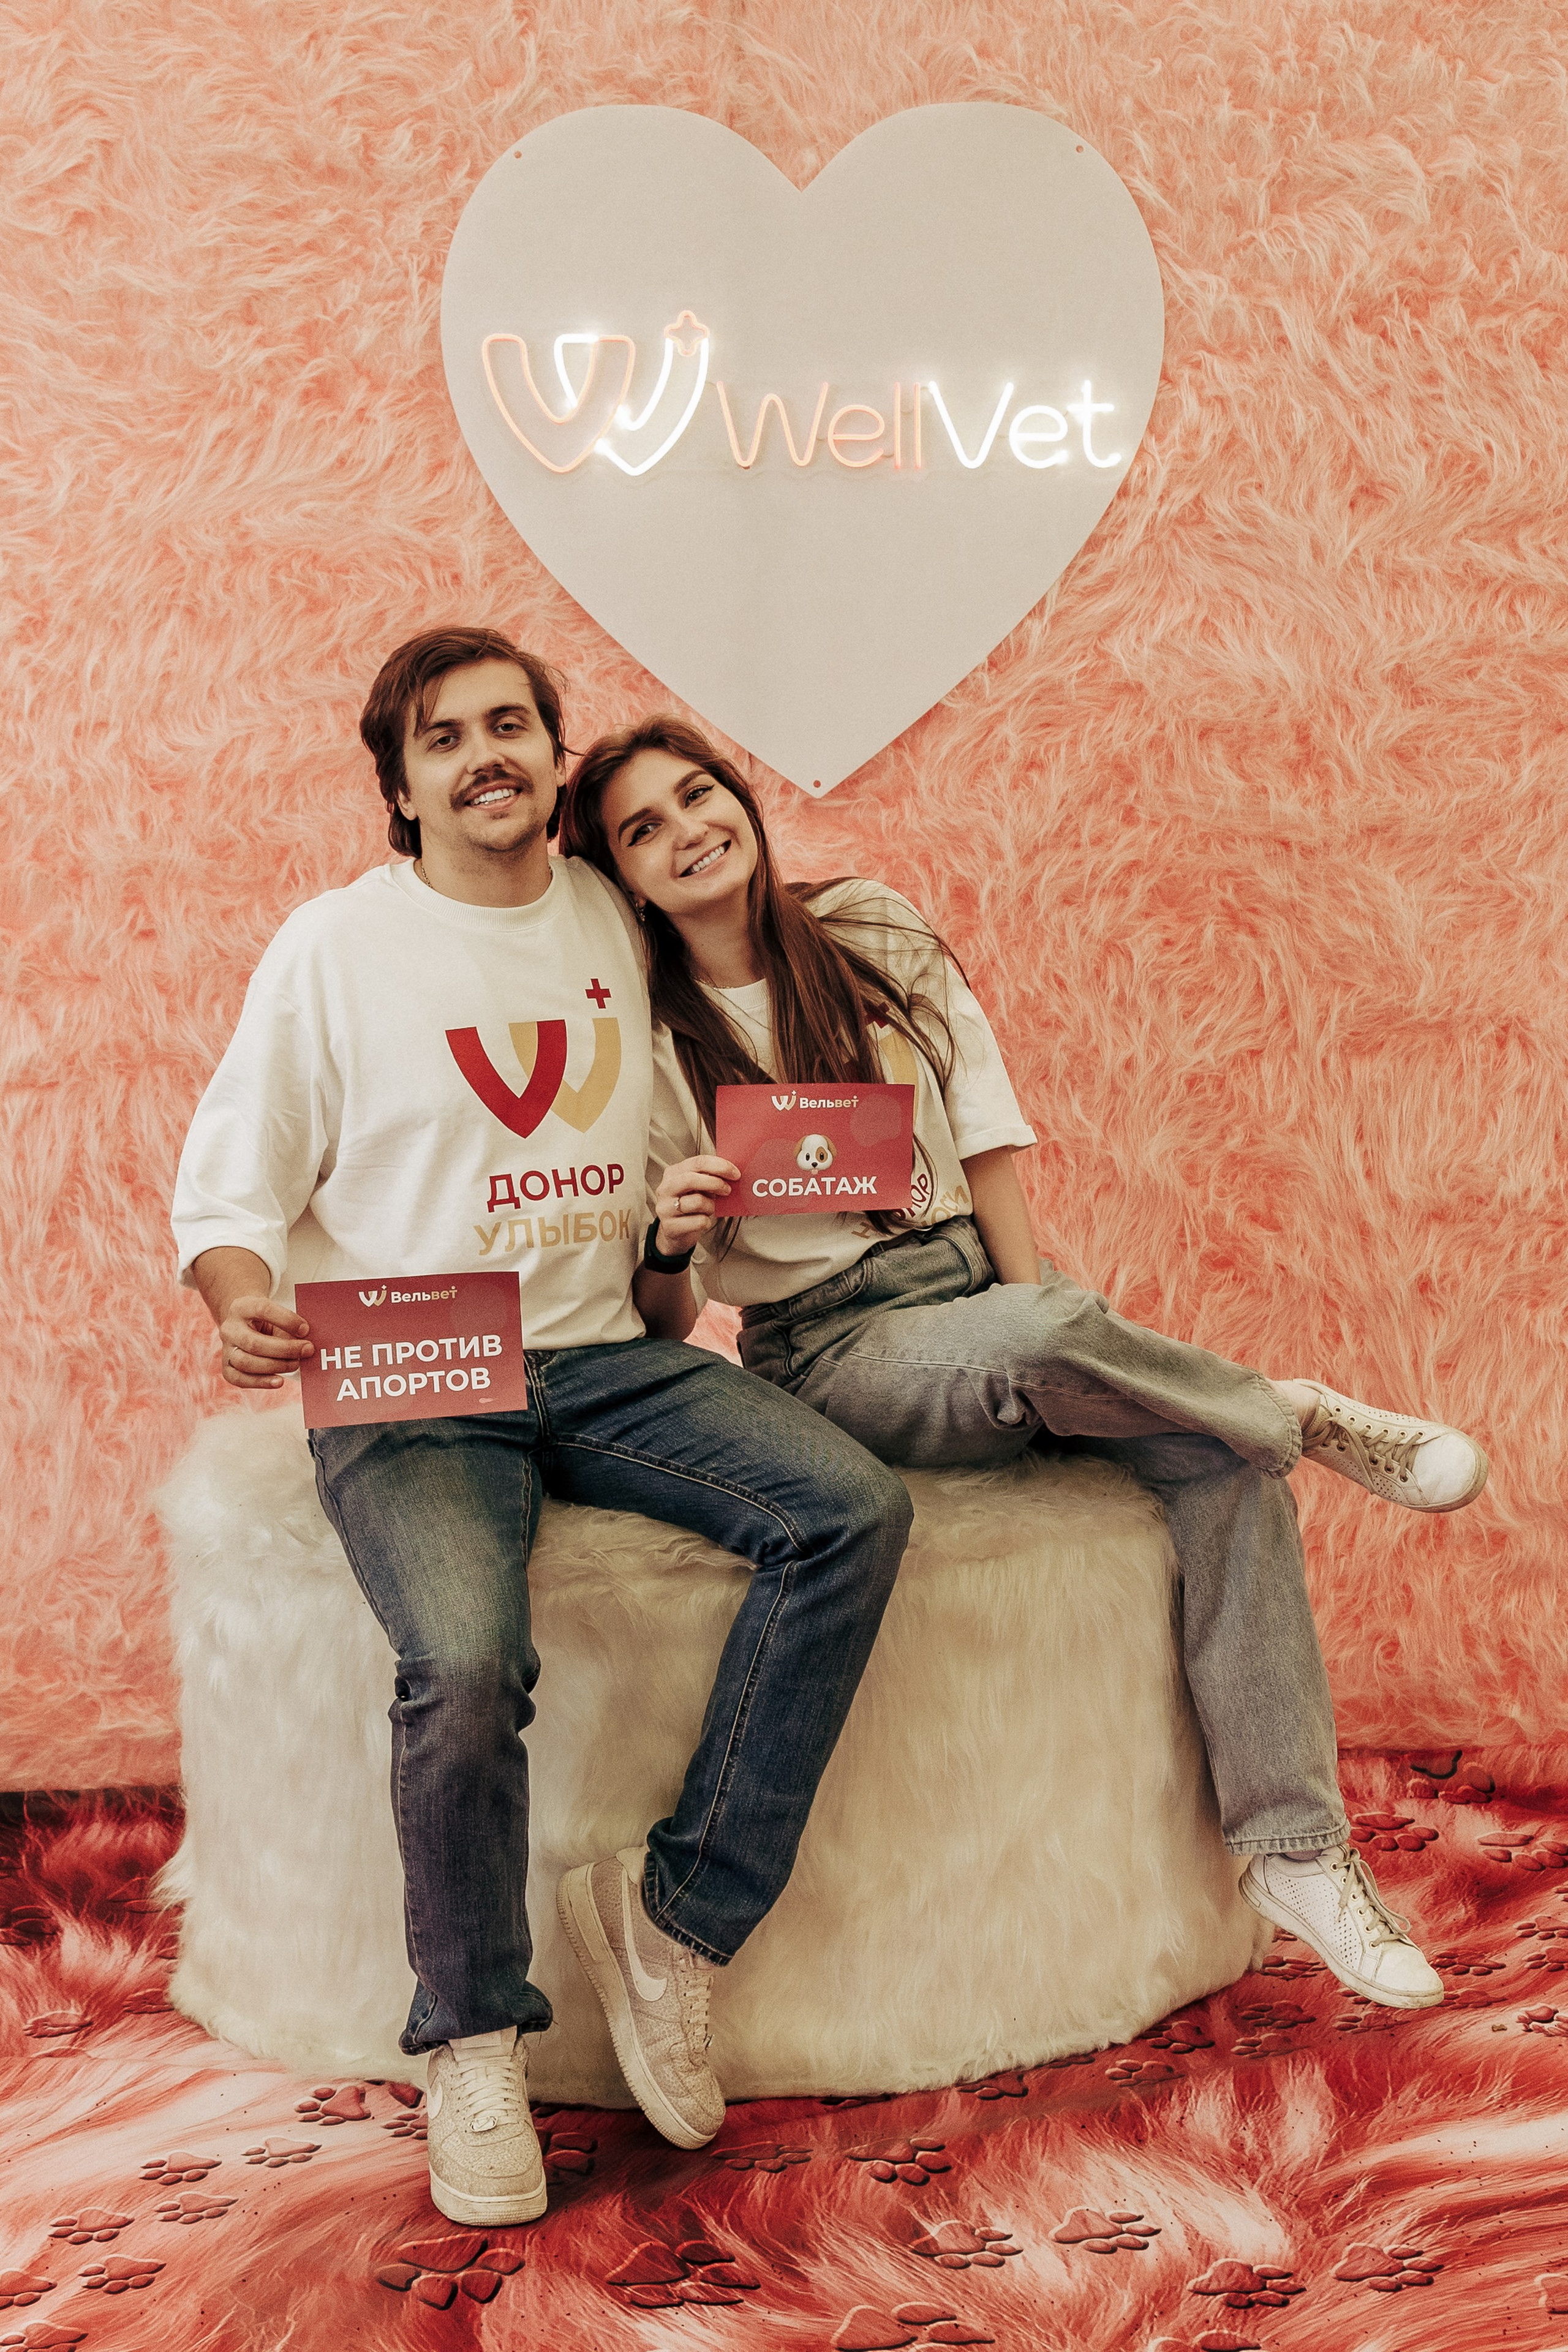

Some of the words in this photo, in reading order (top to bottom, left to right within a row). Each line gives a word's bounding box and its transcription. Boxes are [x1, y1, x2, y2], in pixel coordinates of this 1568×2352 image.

[716, 379, 1121, 470] WellVet
[799, 1096, 859, 1109] Вельвет
[487, 1163, 625, 1213] ДОНОР
[752, 1175, 878, 1197] СОБАТАЖ
[473, 1208, 633, 1256] УЛЫБОК
[391, 1287, 458, 1303] Вельвет
[320, 1345, 363, 1371] НЕ
[372, 1334, 503, 1366] ПРОТИВ
[336, 1367, 491, 1401] АПОРТОВ
